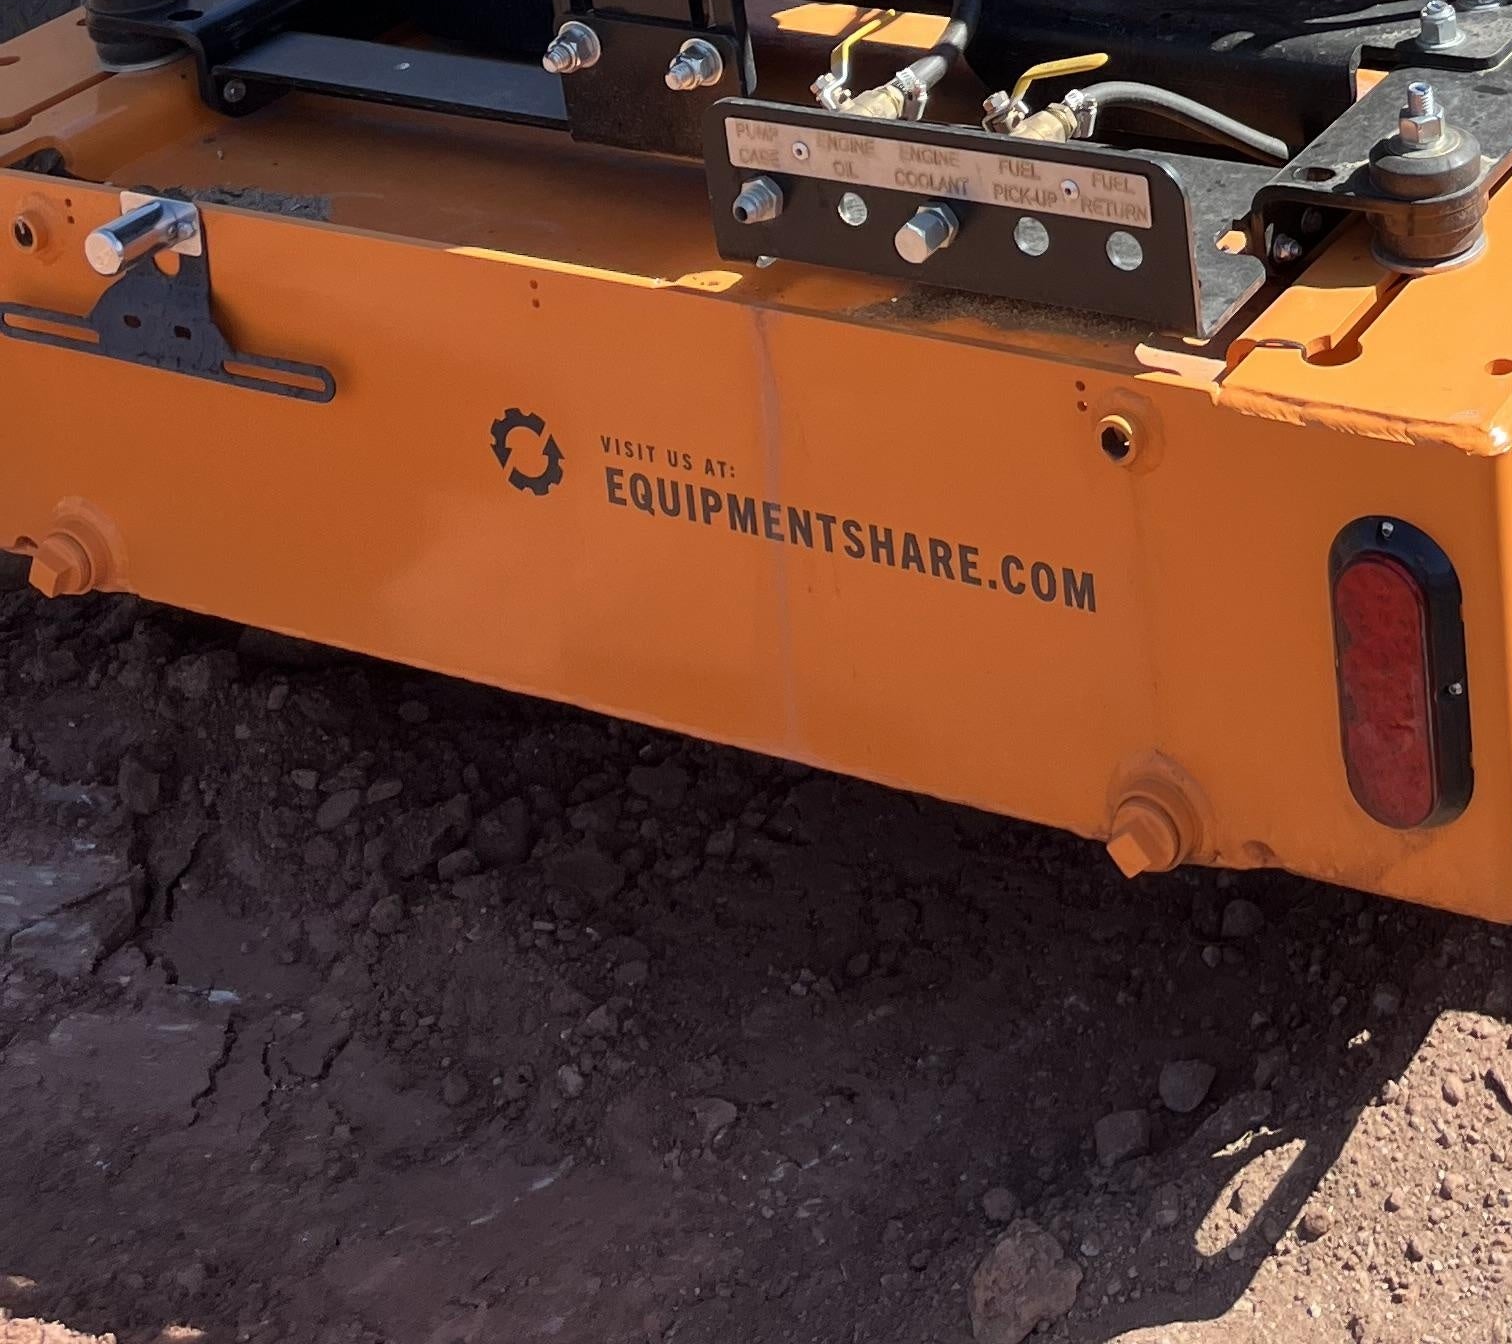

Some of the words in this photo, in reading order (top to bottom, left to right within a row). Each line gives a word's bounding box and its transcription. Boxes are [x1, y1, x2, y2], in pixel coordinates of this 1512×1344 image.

[735, 121, 779, 142] PUMP
[815, 132, 876, 156] ENGINE
[898, 144, 961, 167] ENGINE
[737, 147, 780, 167] CASE
[833, 161, 859, 179] OIL
[998, 158, 1041, 181] FUEL
[894, 168, 970, 196] COOLANT
[1091, 172, 1135, 195] FUEL
[993, 183, 1058, 209] PICK-UP
[1081, 197, 1148, 222] RETURN
[600, 435, 655, 462] VISIT
[667, 449, 692, 471] US
[704, 458, 736, 479] AT:
[605, 466, 1097, 613] EQUIPMENTSHARE.COM
